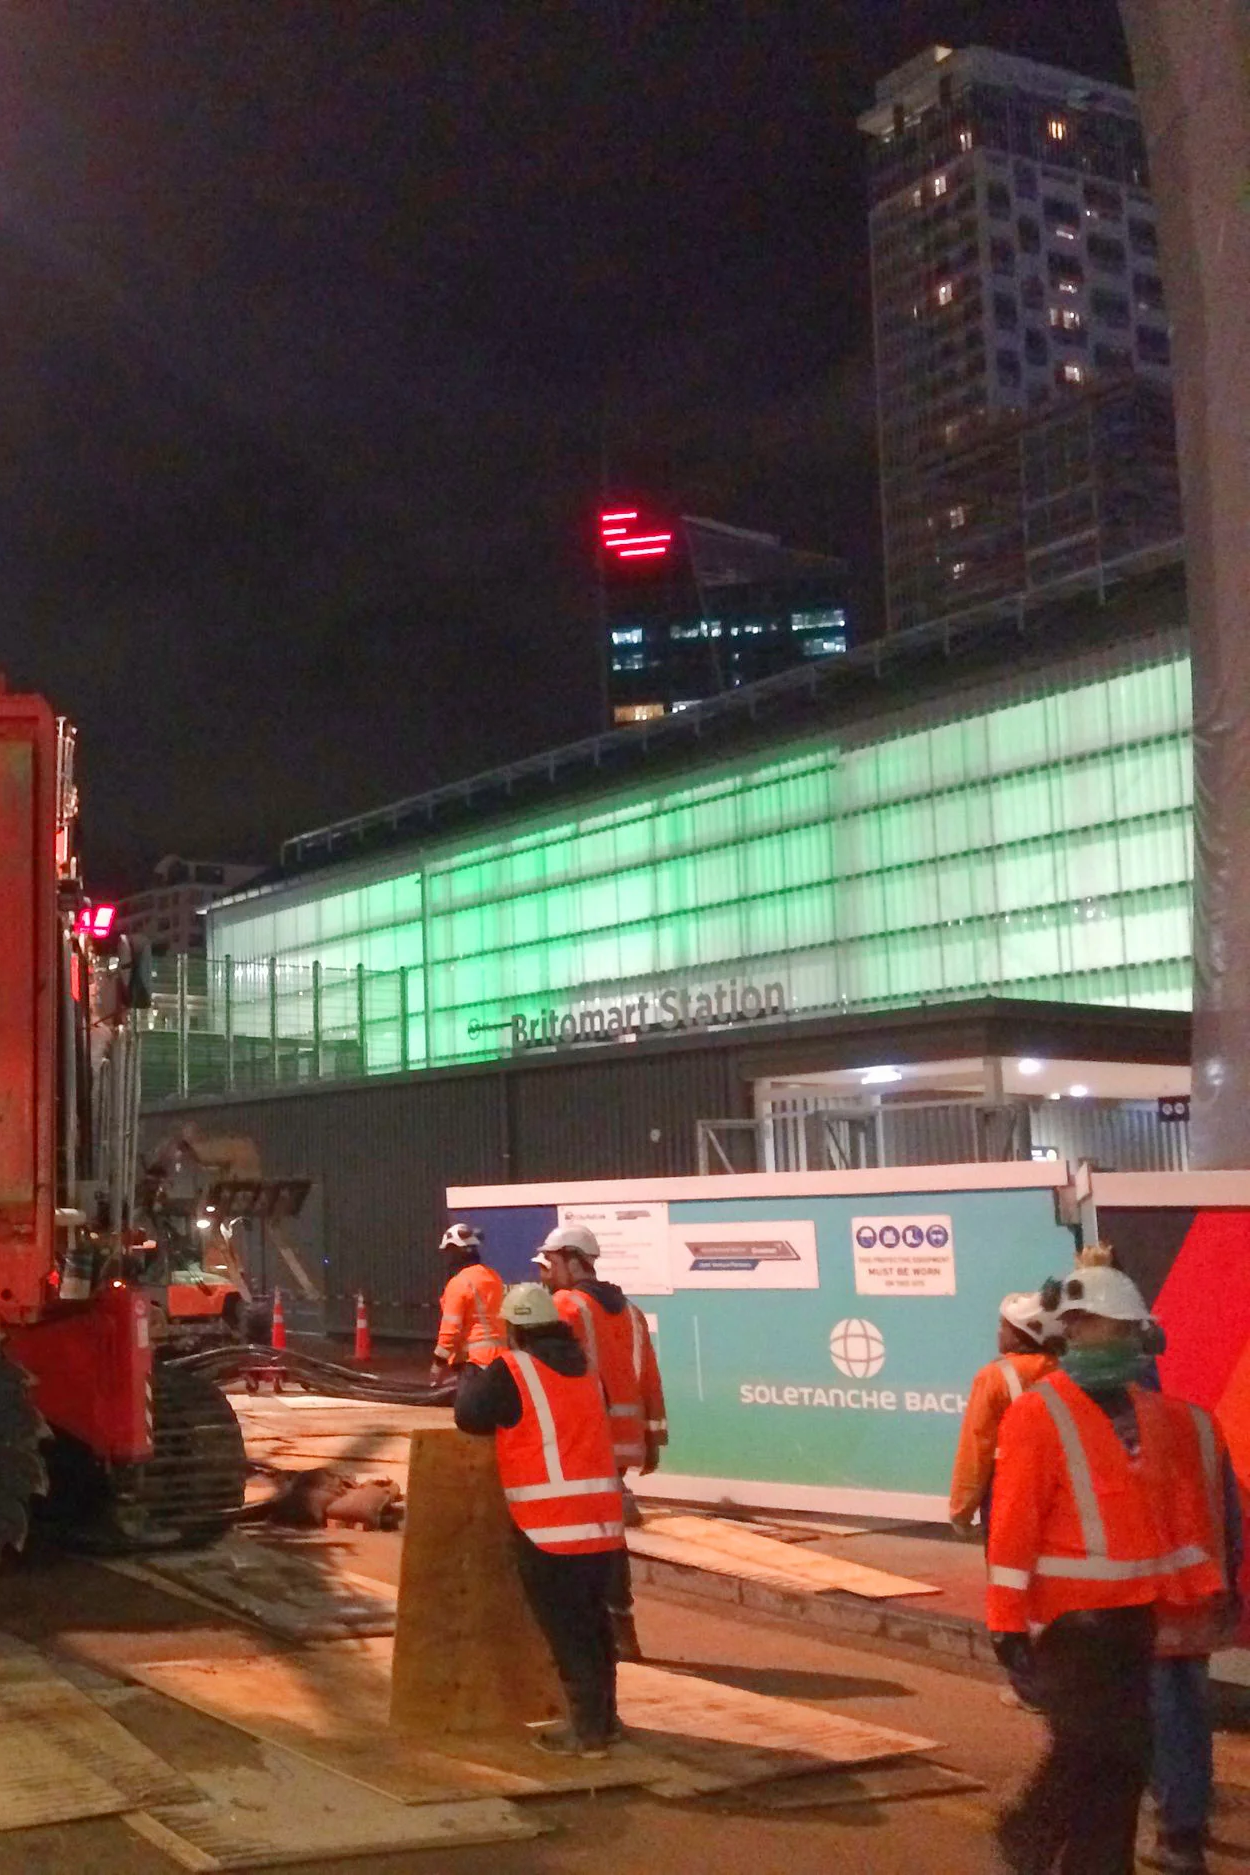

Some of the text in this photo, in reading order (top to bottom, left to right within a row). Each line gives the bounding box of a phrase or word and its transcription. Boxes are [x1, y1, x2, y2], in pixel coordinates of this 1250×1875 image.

[511, 979, 786, 1048] Britomart Station
[868, 1267, 942, 1277] MUST BE WORN
